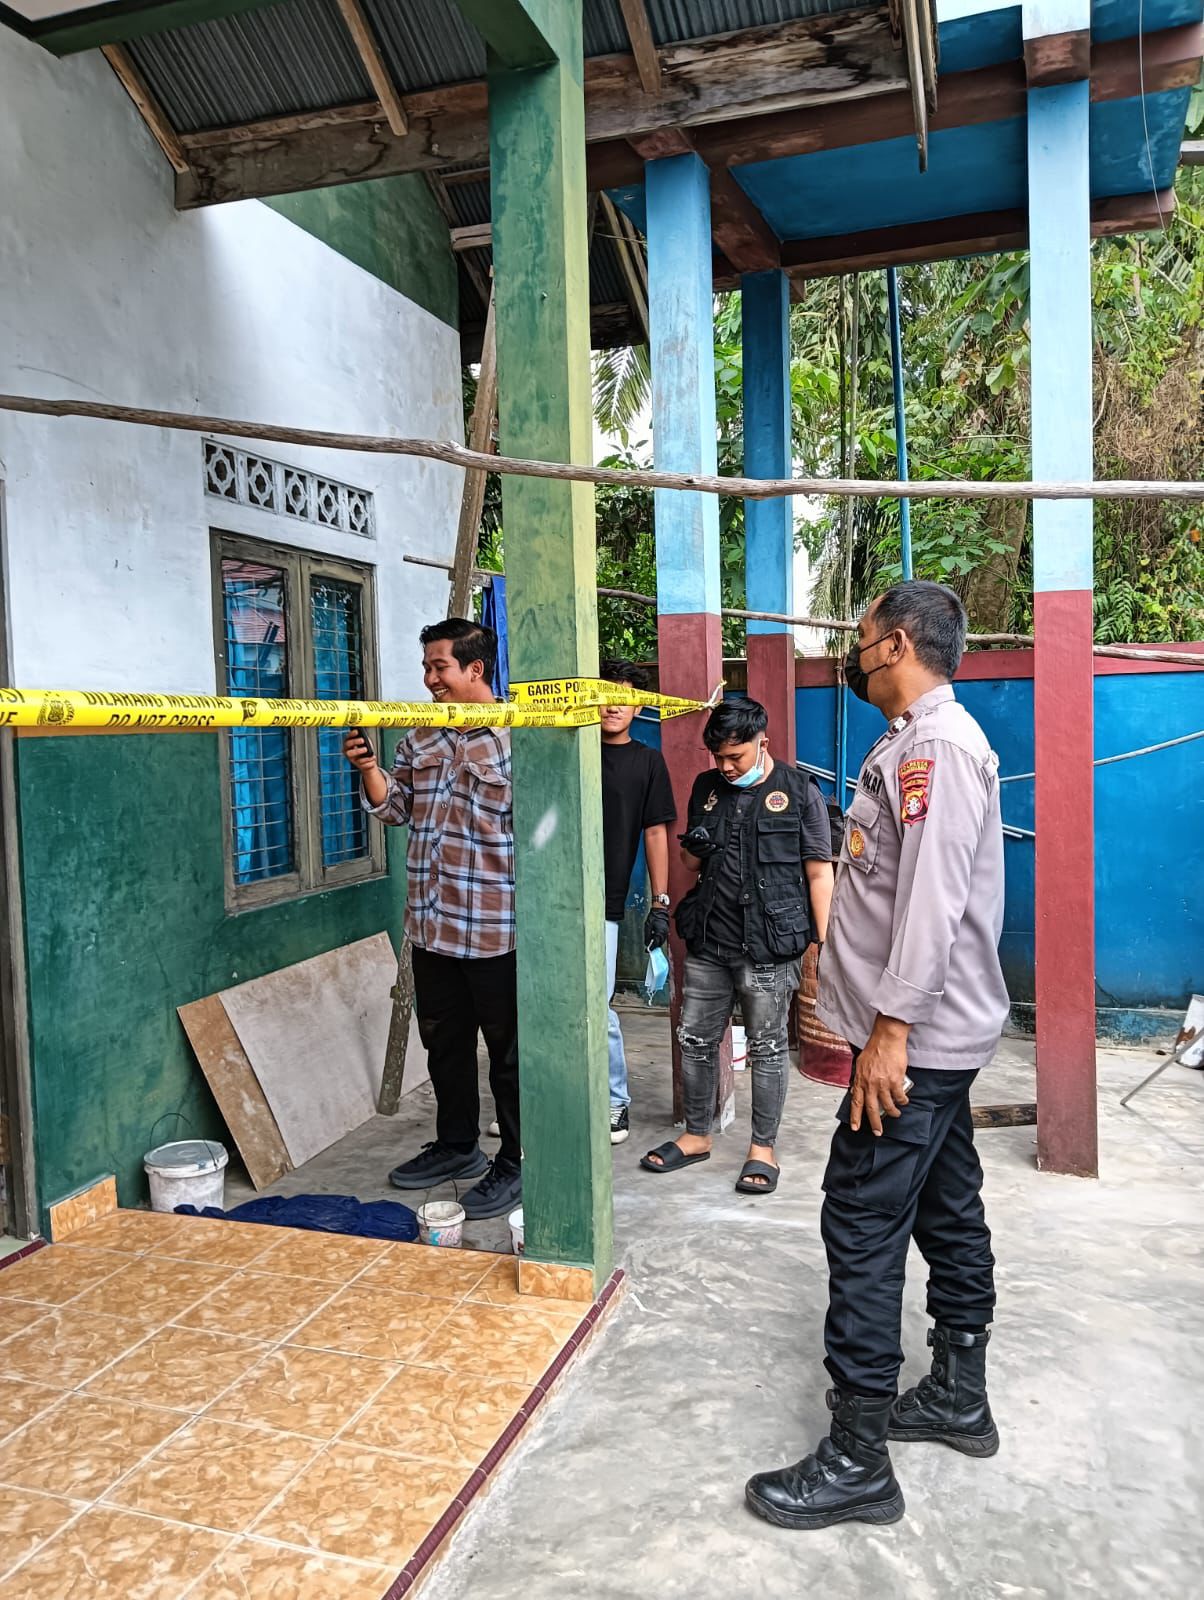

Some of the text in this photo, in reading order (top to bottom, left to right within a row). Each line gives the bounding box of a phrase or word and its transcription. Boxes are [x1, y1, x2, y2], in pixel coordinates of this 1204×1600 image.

[528, 683, 561, 697] GARIS
[83, 691, 233, 710] DILARANG MELINTAS
[264, 698, 340, 711] GARIS POLISI
[104, 714, 131, 727] DO
[134, 714, 167, 727] NOT
[270, 716, 336, 727] POLICE LINE
